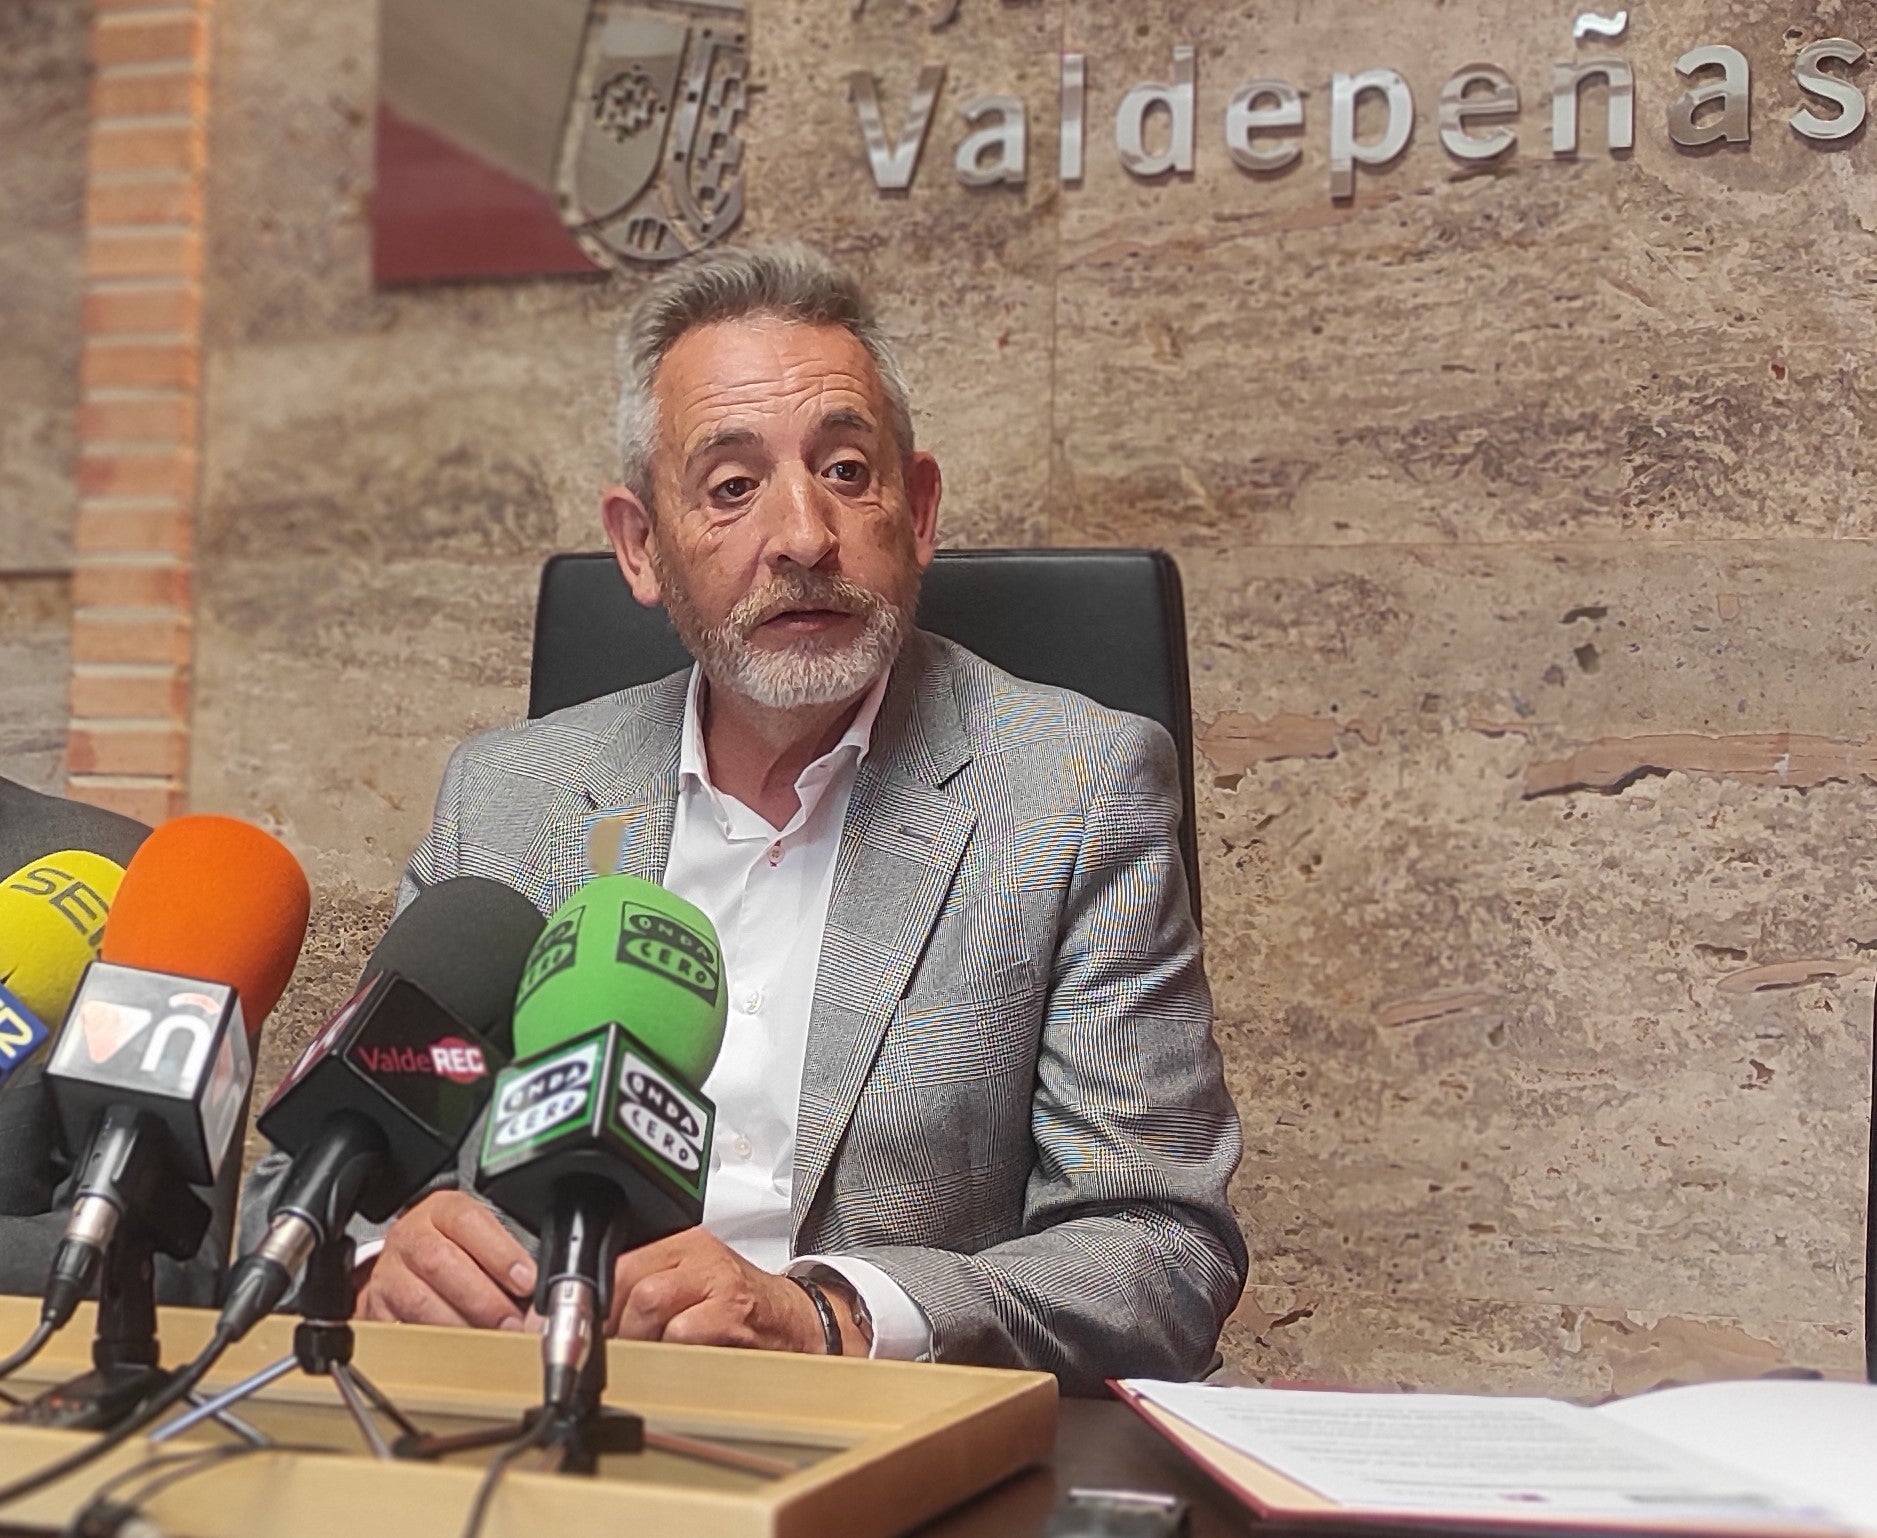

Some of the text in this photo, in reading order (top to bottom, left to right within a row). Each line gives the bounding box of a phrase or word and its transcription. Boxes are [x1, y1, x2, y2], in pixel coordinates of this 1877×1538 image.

[848, 10, 1866, 200] Valdepeñas
[638, 916, 709, 958] ONDA
[640, 942, 708, 984] CERO
[357, 1045, 486, 1075] ValdeREC
[511, 1066, 581, 1107] ONDA
[632, 1075, 695, 1134] ONDA
[508, 1096, 576, 1136] CERO
[631, 1109, 689, 1162] CERO
